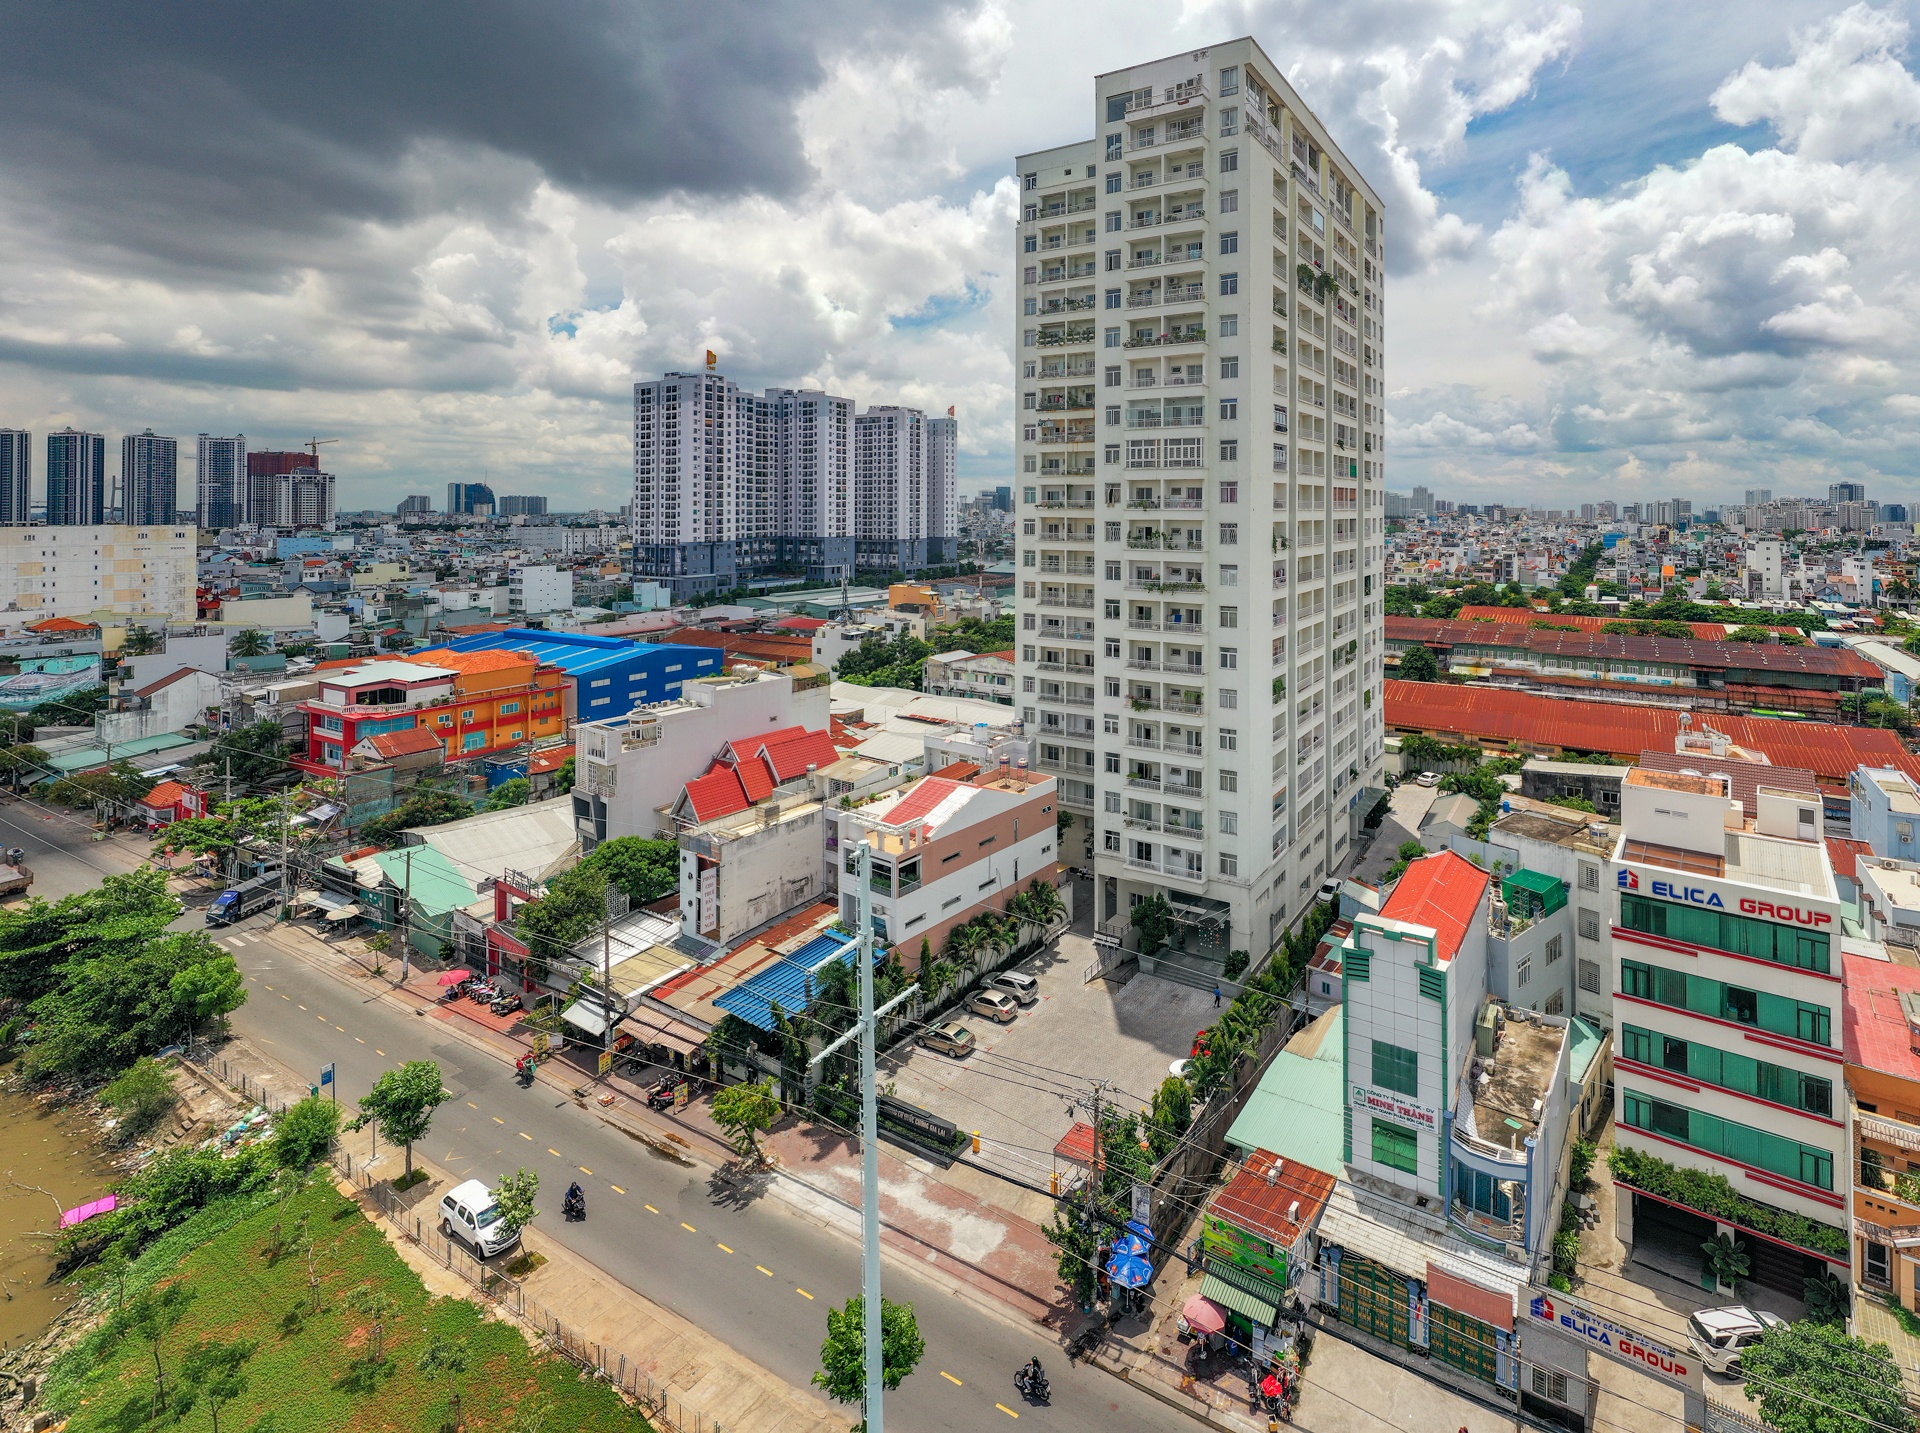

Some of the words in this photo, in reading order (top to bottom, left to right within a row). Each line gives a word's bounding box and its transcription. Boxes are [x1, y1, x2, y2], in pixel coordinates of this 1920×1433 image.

[1652, 881, 1724, 908] ELICA
[1740, 897, 1832, 927] GROUP
[1367, 1089, 1382, 1098] CÔNG
[1390, 1096, 1405, 1105] TNHH
[1367, 1096, 1394, 1111] MINH
[1397, 1105, 1434, 1123] THÀNH
[1571, 1309, 1590, 1322] CÔG
[1615, 1328, 1634, 1341] PH
[1561, 1315, 1612, 1346] ELICA
[1619, 1340, 1687, 1377] GROUP
